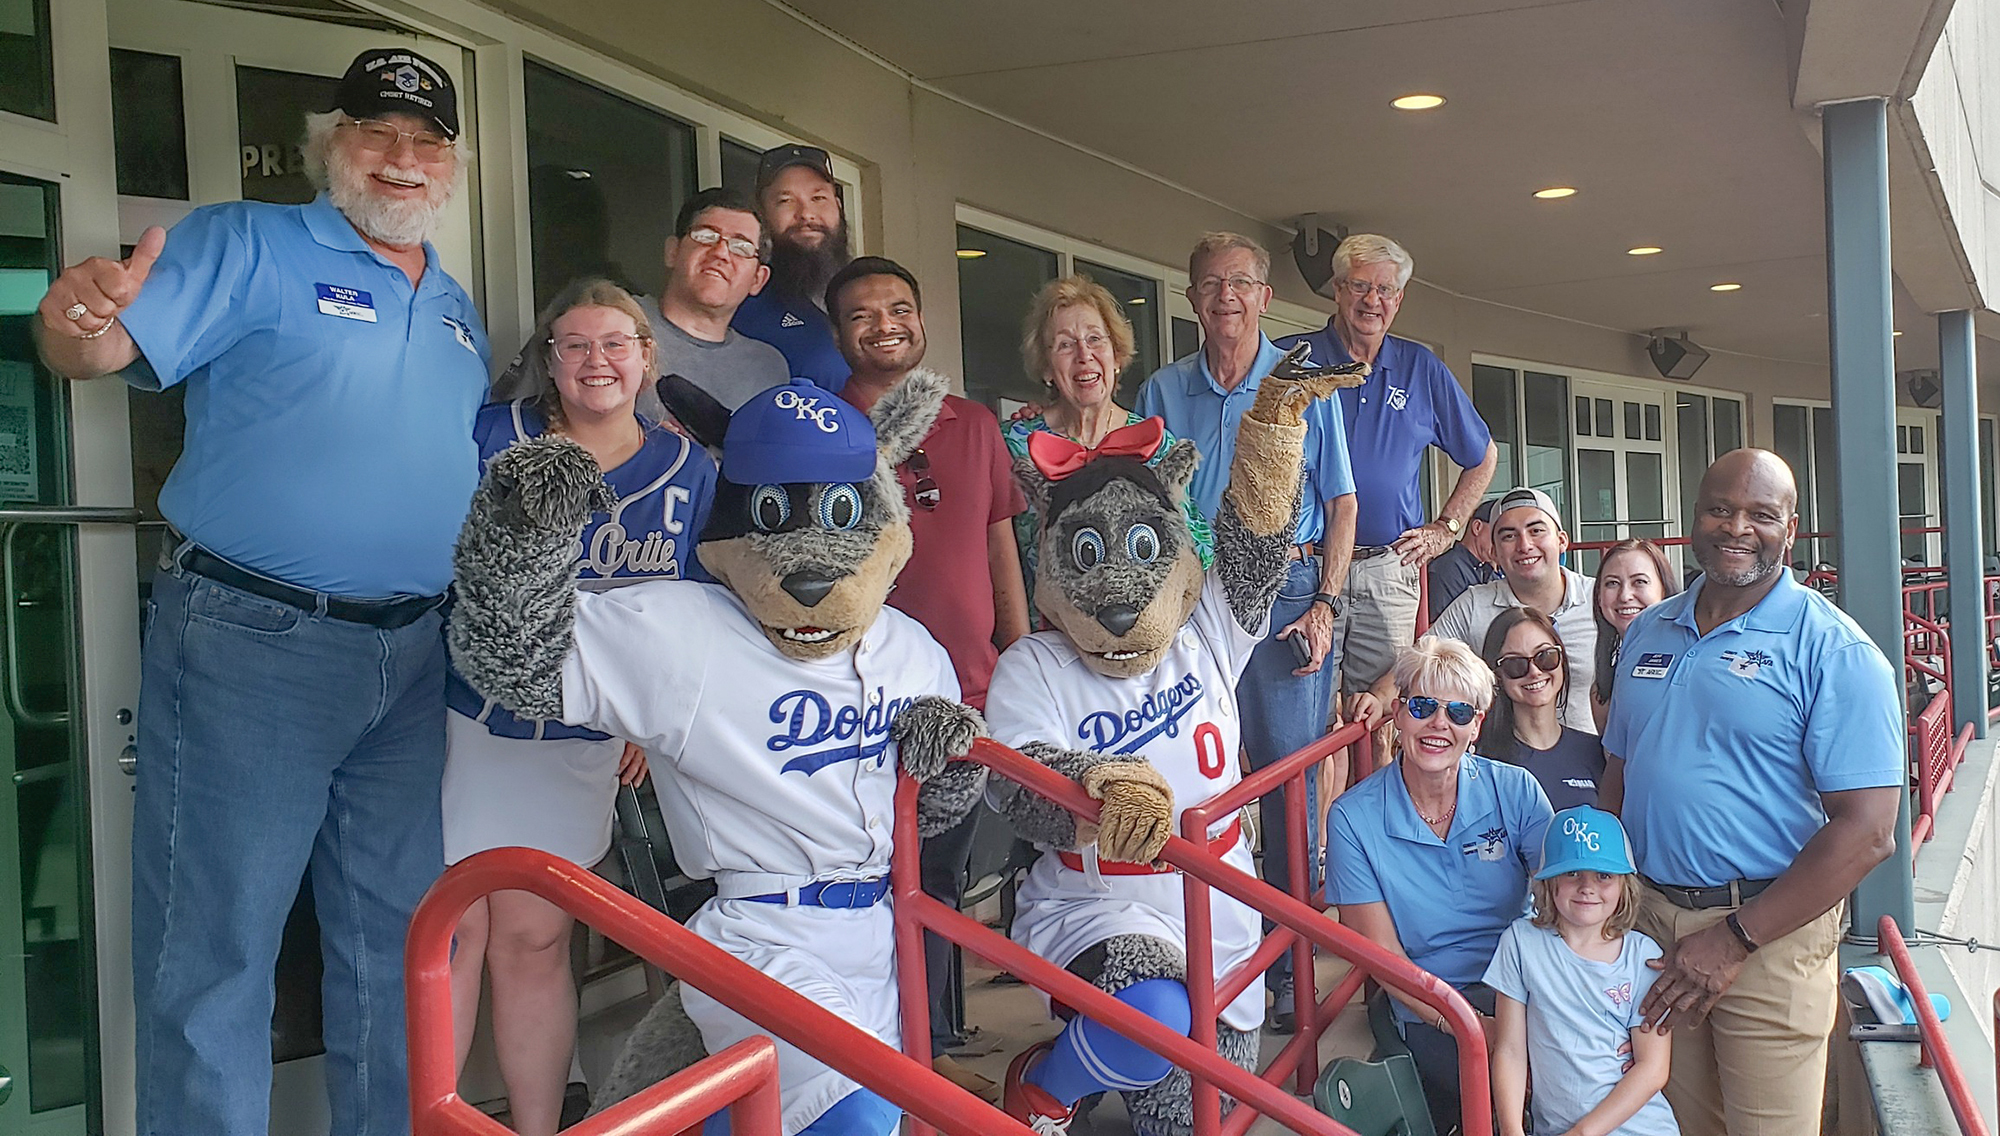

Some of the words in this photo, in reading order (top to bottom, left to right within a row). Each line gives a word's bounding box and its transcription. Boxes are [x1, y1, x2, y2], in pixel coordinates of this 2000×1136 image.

[388, 54, 412, 64] AIR
[404, 92, 433, 108] RETIRED
[329, 285, 358, 297] WALTER
[335, 293, 355, 301] KULA
[774, 390, 839, 433] OKC
[664, 485, 690, 535] C
[1078, 672, 1203, 754] Dodgers
[1193, 721, 1226, 780] 0
[1562, 817, 1600, 851] OKC
